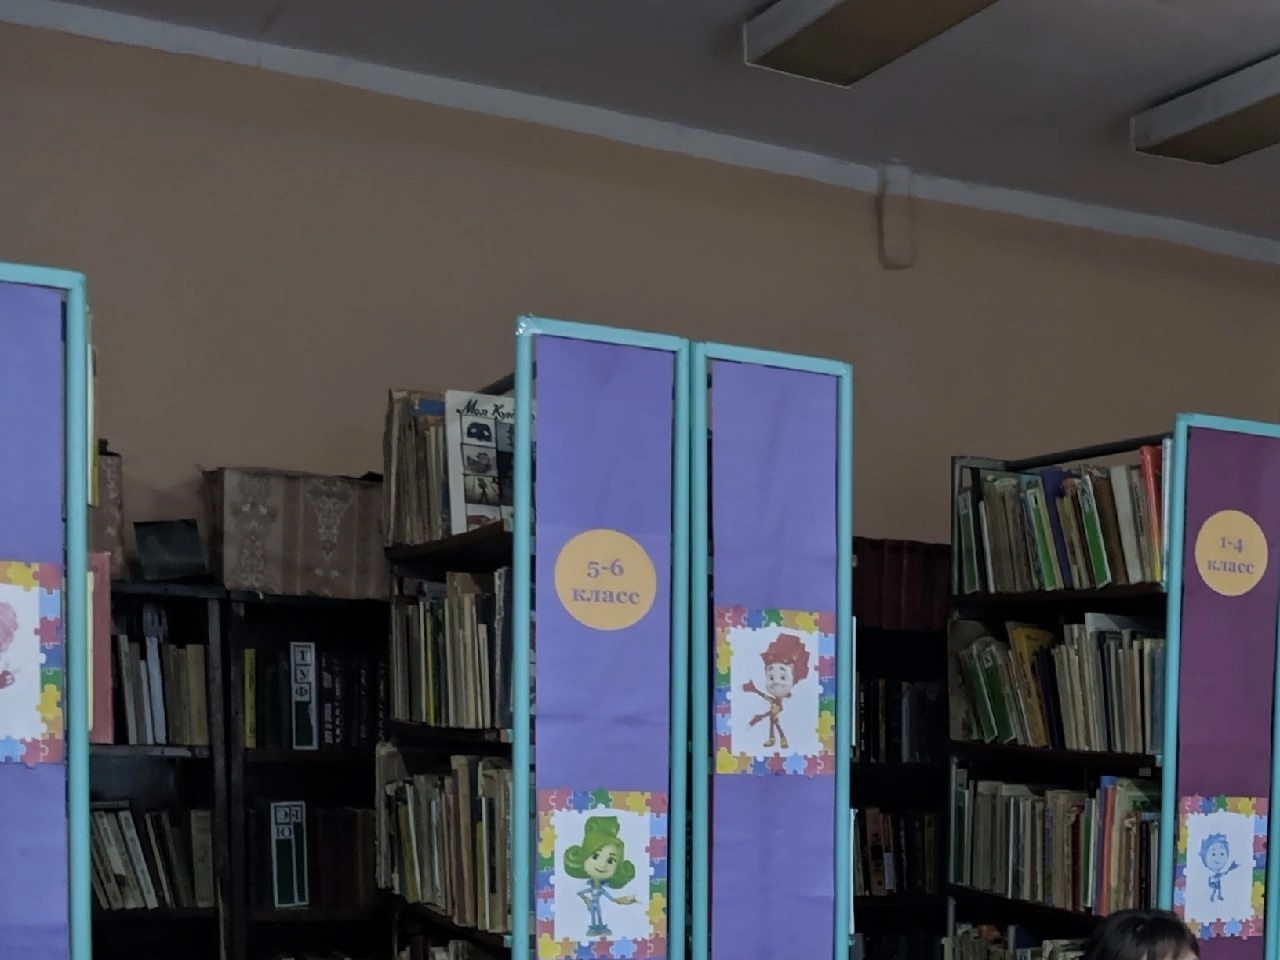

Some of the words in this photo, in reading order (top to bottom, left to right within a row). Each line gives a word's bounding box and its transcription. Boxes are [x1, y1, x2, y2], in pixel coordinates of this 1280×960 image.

[1219, 535, 1244, 553] 1-4
[586, 558, 625, 578] 5-6
[1205, 558, 1255, 575] класс
[571, 588, 641, 606] класс
